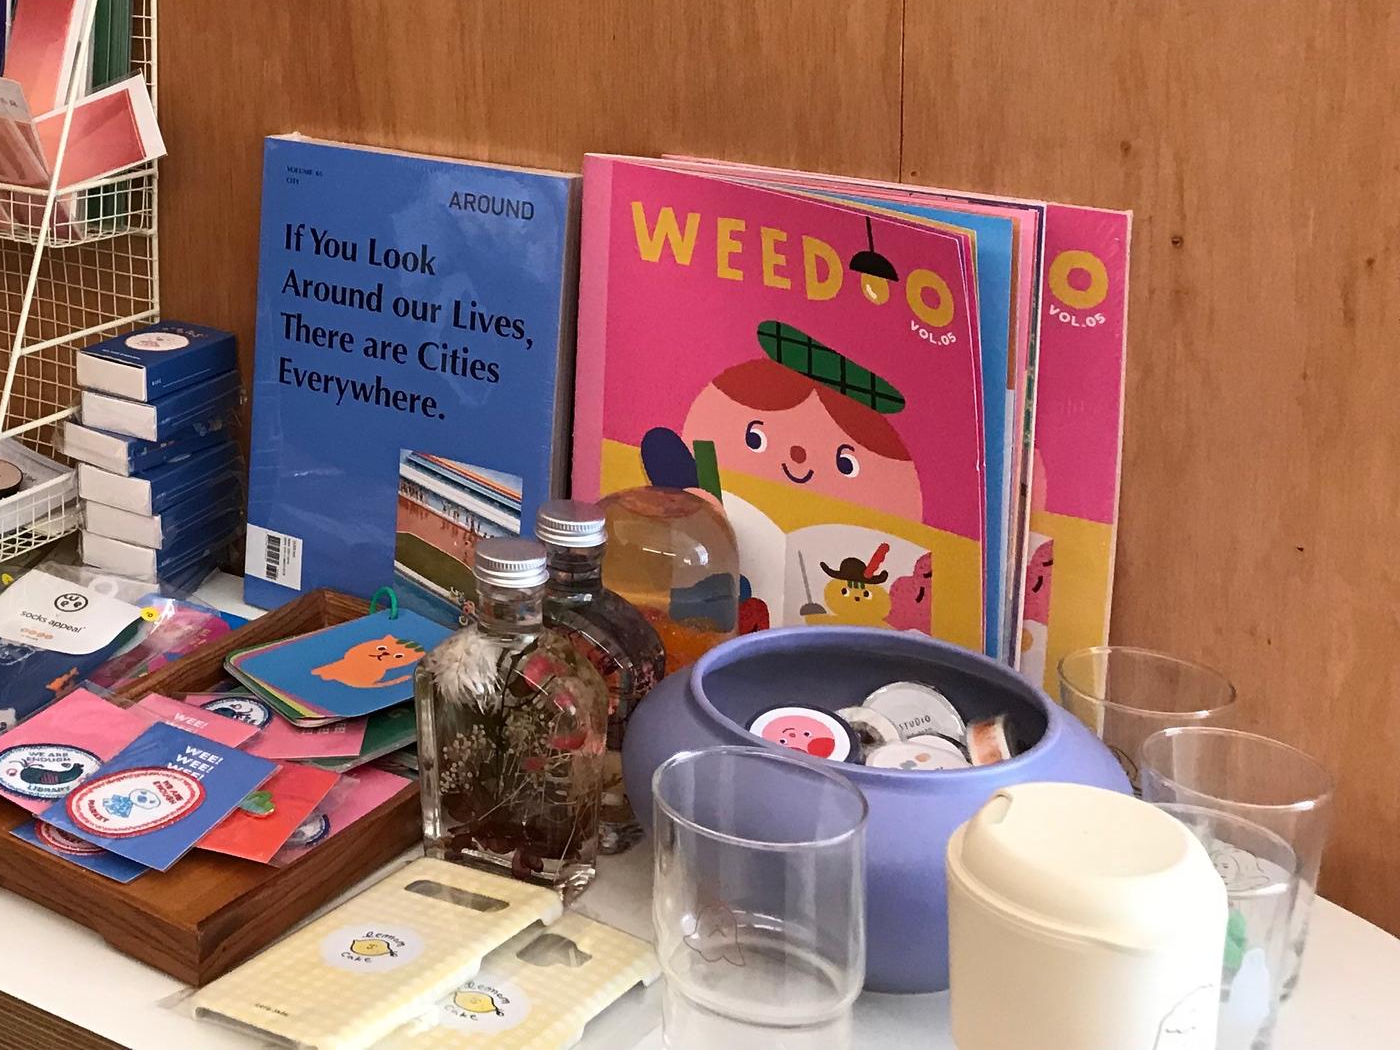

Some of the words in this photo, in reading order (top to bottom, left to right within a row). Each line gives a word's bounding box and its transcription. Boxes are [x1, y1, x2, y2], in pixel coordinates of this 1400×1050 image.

[286, 165, 313, 177] VOLUME
[448, 190, 535, 221] AROUND
[284, 223, 306, 252] If
[310, 228, 358, 262] You
[368, 237, 437, 276] Look
[281, 268, 384, 313] Around
[392, 296, 442, 324] our
[452, 300, 534, 350] Lives,
[1048, 302, 1107, 328] VOL.05
[908, 319, 957, 347] VOL.05
[280, 311, 355, 354] There
[362, 336, 408, 365] are
[417, 341, 501, 384] Cities
[278, 356, 446, 421] Everywhere.
[20, 608, 48, 627] socks
[48, 618, 83, 634] appeal
[174, 712, 208, 730] WEE!
[174, 753, 215, 774] WEE!
[184, 744, 224, 765] WEE!
